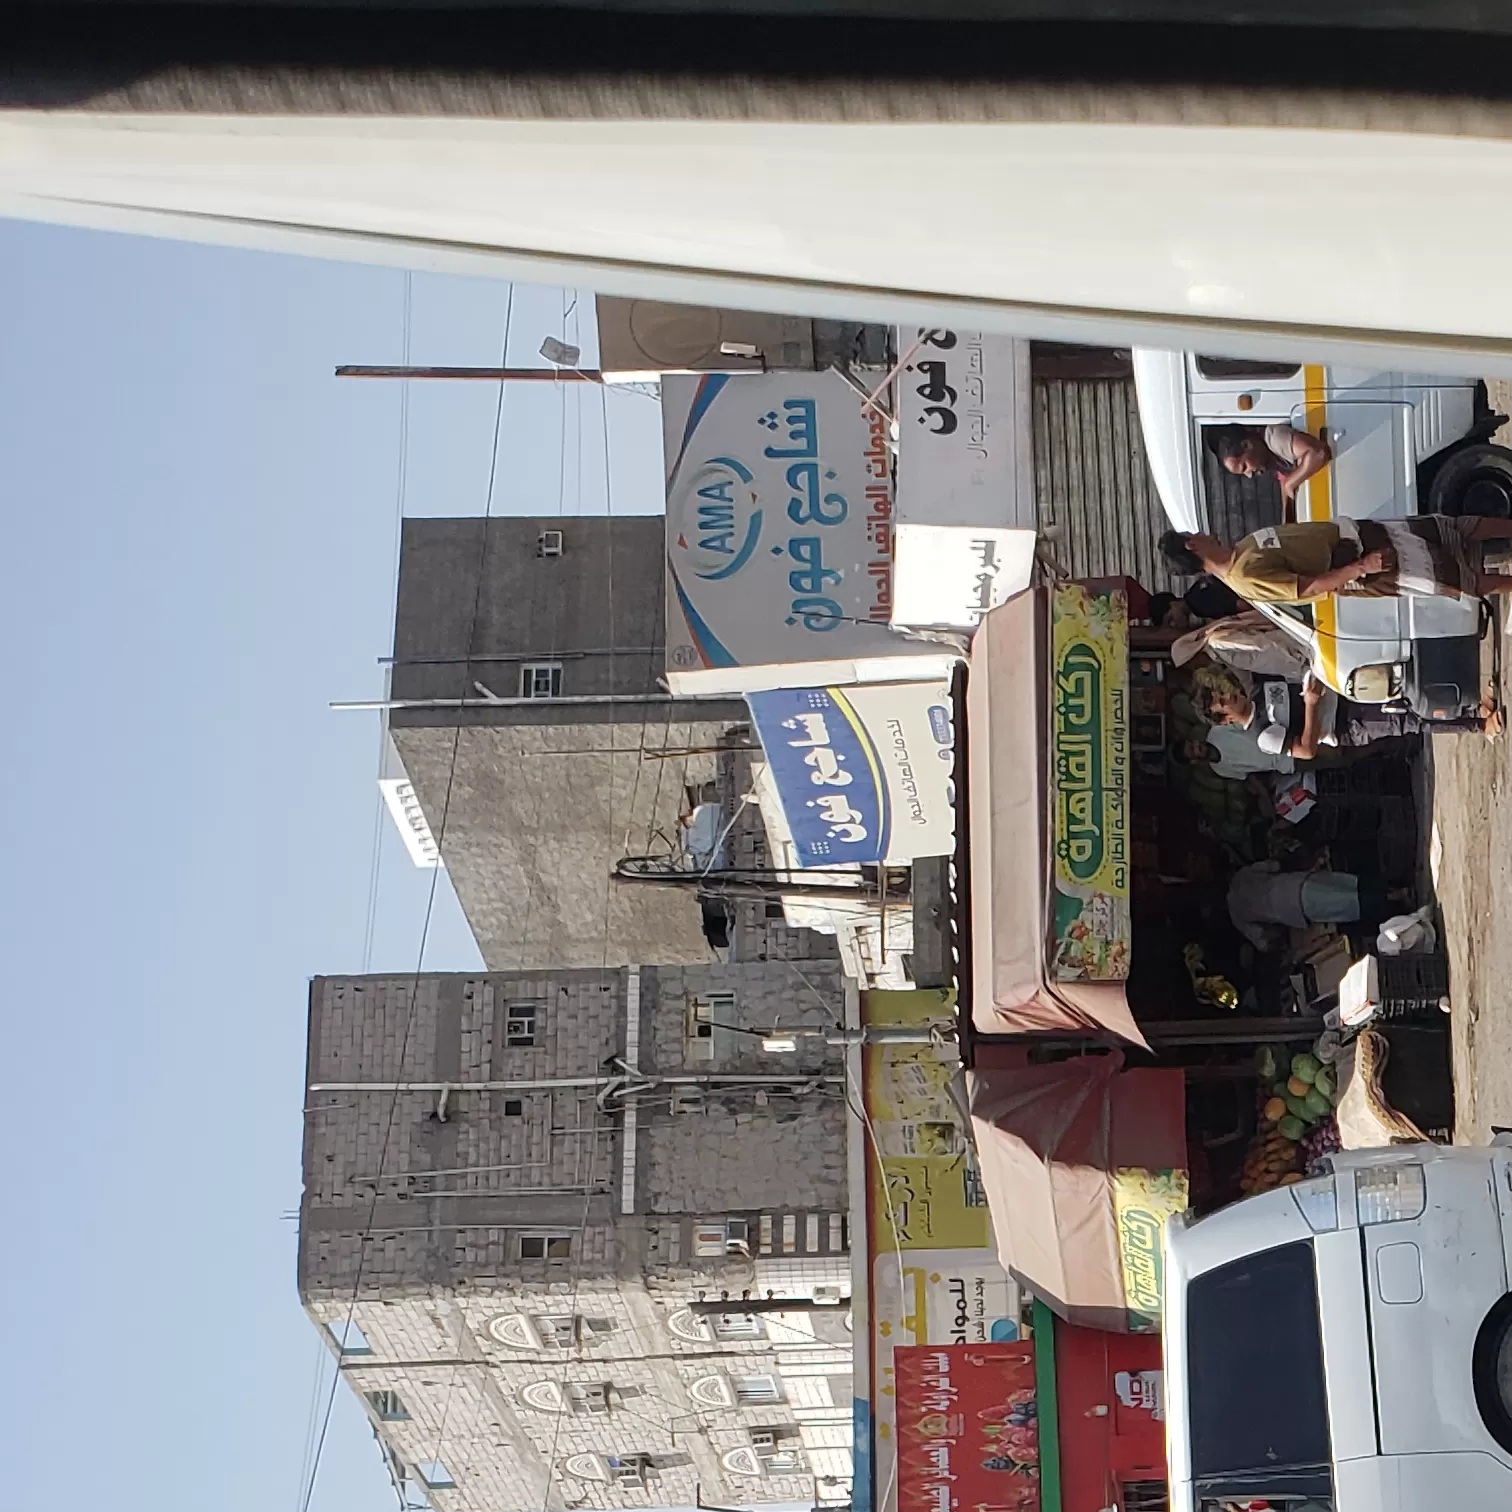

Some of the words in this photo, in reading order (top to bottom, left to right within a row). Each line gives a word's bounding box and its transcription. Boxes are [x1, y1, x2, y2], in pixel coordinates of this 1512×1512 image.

[905, 361, 958, 436] فون
[757, 399, 848, 526] شاجع
[697, 481, 735, 554] AMA
[770, 536, 843, 633] فون
[1057, 654, 1100, 723] ركن
[781, 713, 853, 786] شاجع
[806, 794, 867, 842] فون
[1057, 732, 1100, 861] القاهرة
